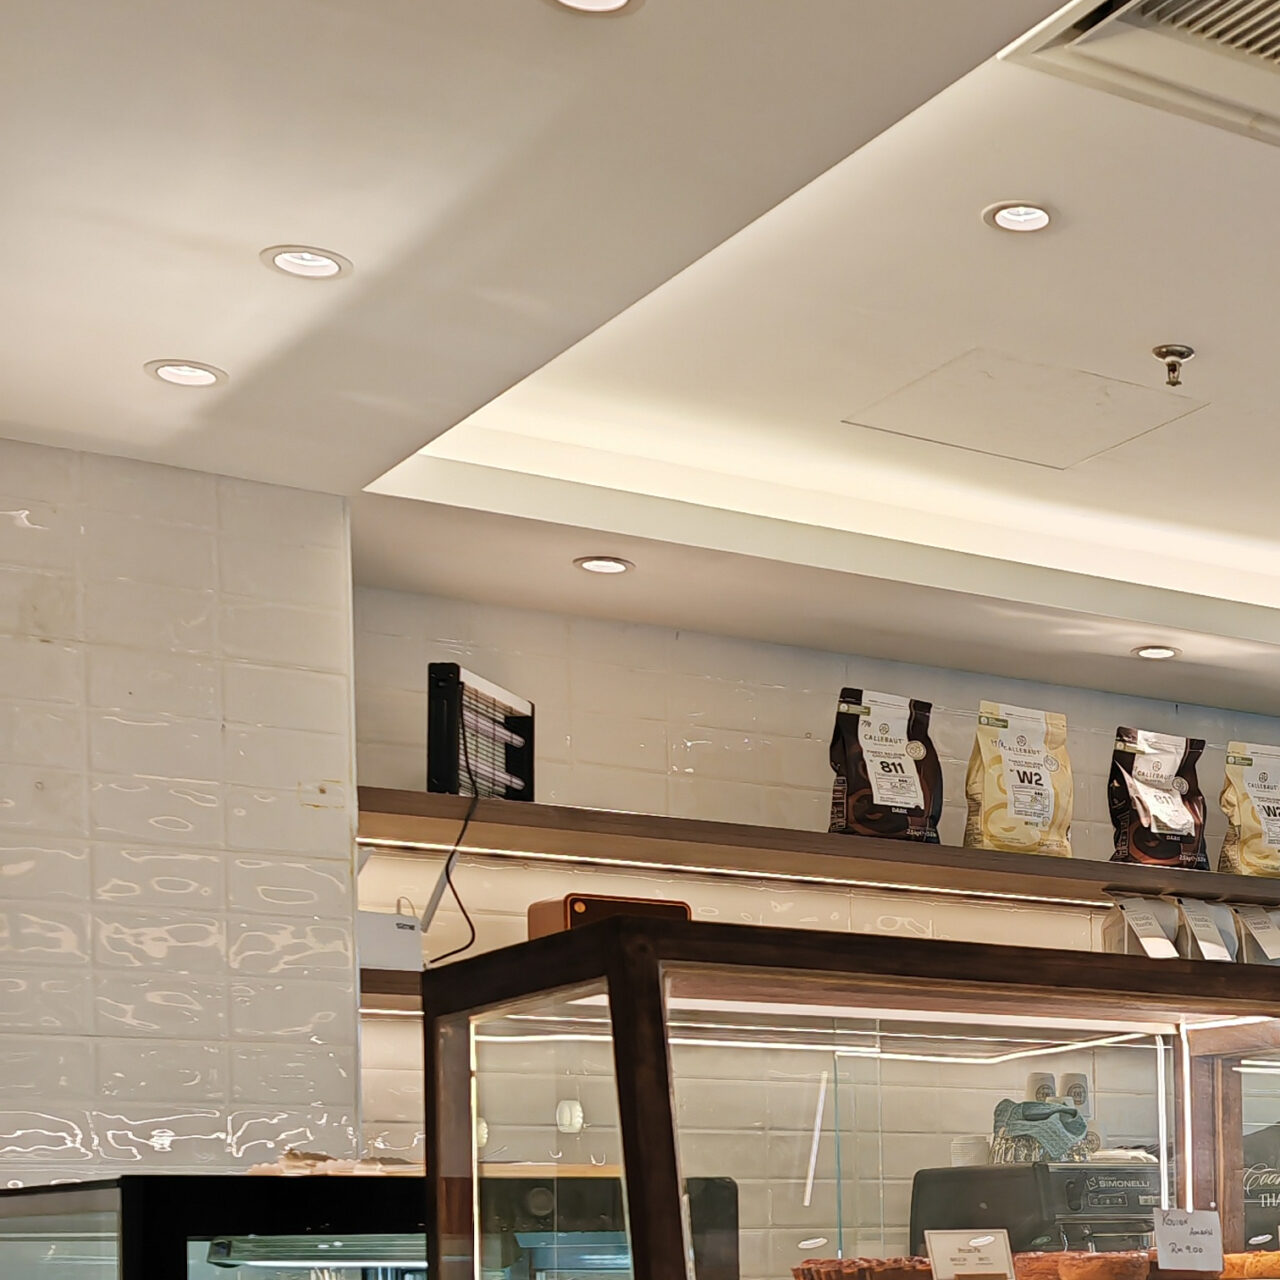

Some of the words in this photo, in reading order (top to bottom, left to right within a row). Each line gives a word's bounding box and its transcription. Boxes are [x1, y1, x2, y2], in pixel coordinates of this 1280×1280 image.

[864, 733, 904, 746] CALLEBAUT
[879, 760, 905, 775] 811
[1016, 769, 1044, 787] W2
[1098, 1180, 1150, 1188] SIMONELLI
